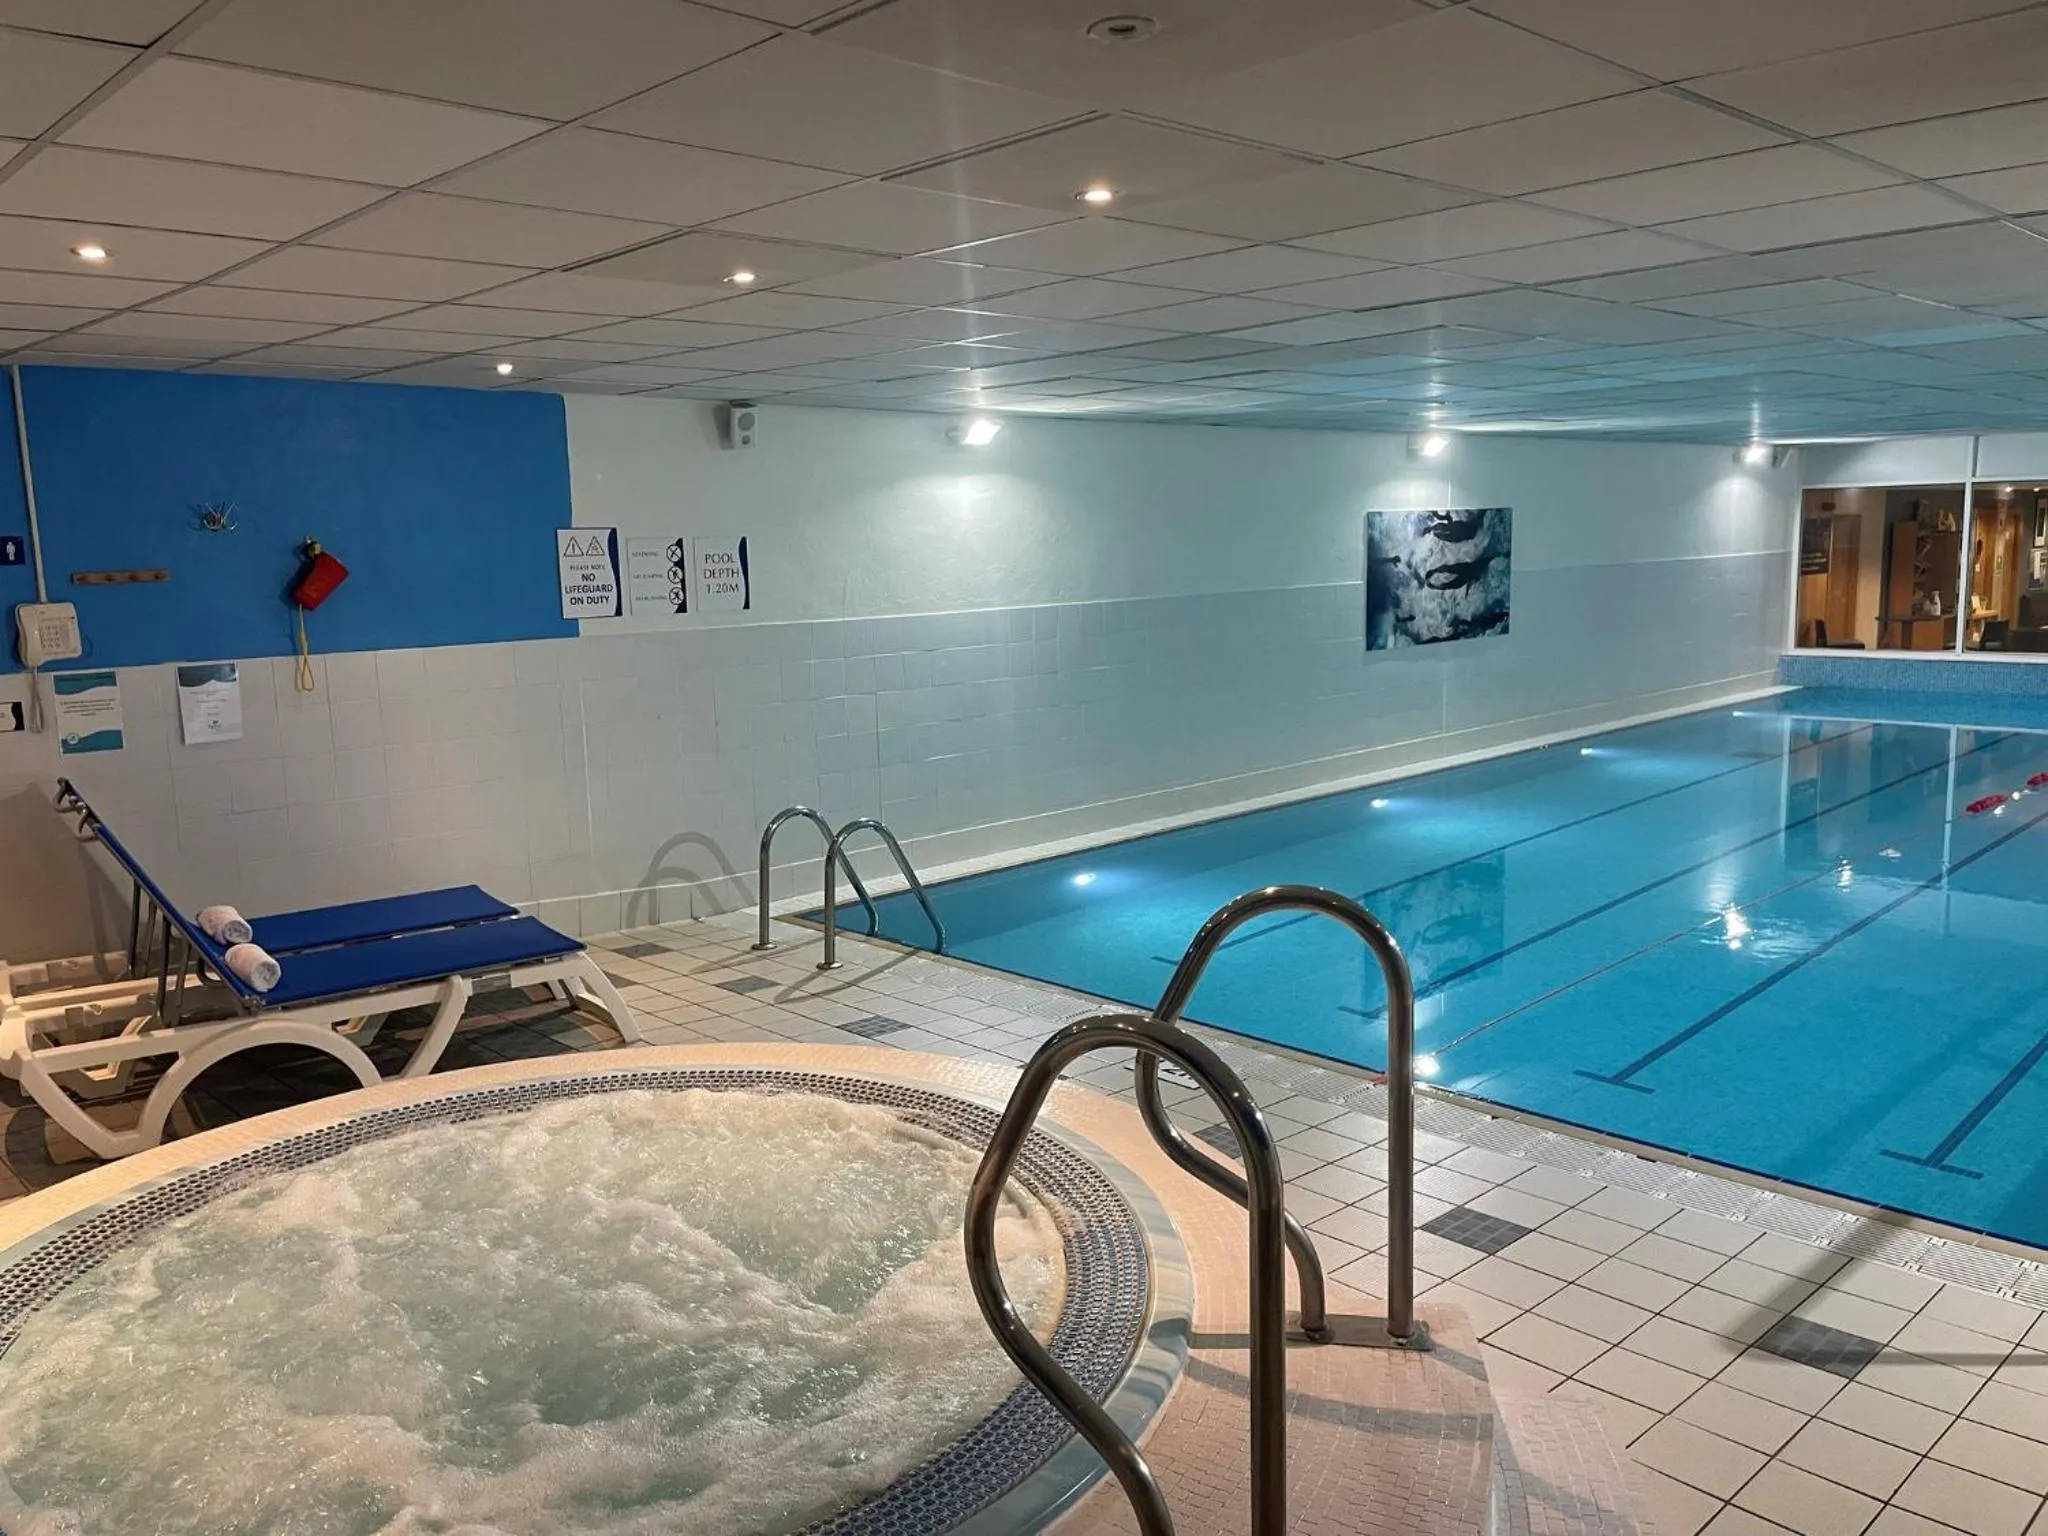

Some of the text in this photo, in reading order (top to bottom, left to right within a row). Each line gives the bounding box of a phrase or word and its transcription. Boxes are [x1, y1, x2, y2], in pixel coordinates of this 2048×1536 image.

[704, 553, 736, 564] POOL
[581, 573, 596, 582] NO
[703, 567, 739, 579] DEPTH
[565, 584, 613, 594] LIFEGUARD
[705, 583, 740, 594] 1.20M
[570, 596, 610, 605] ON DUTY
